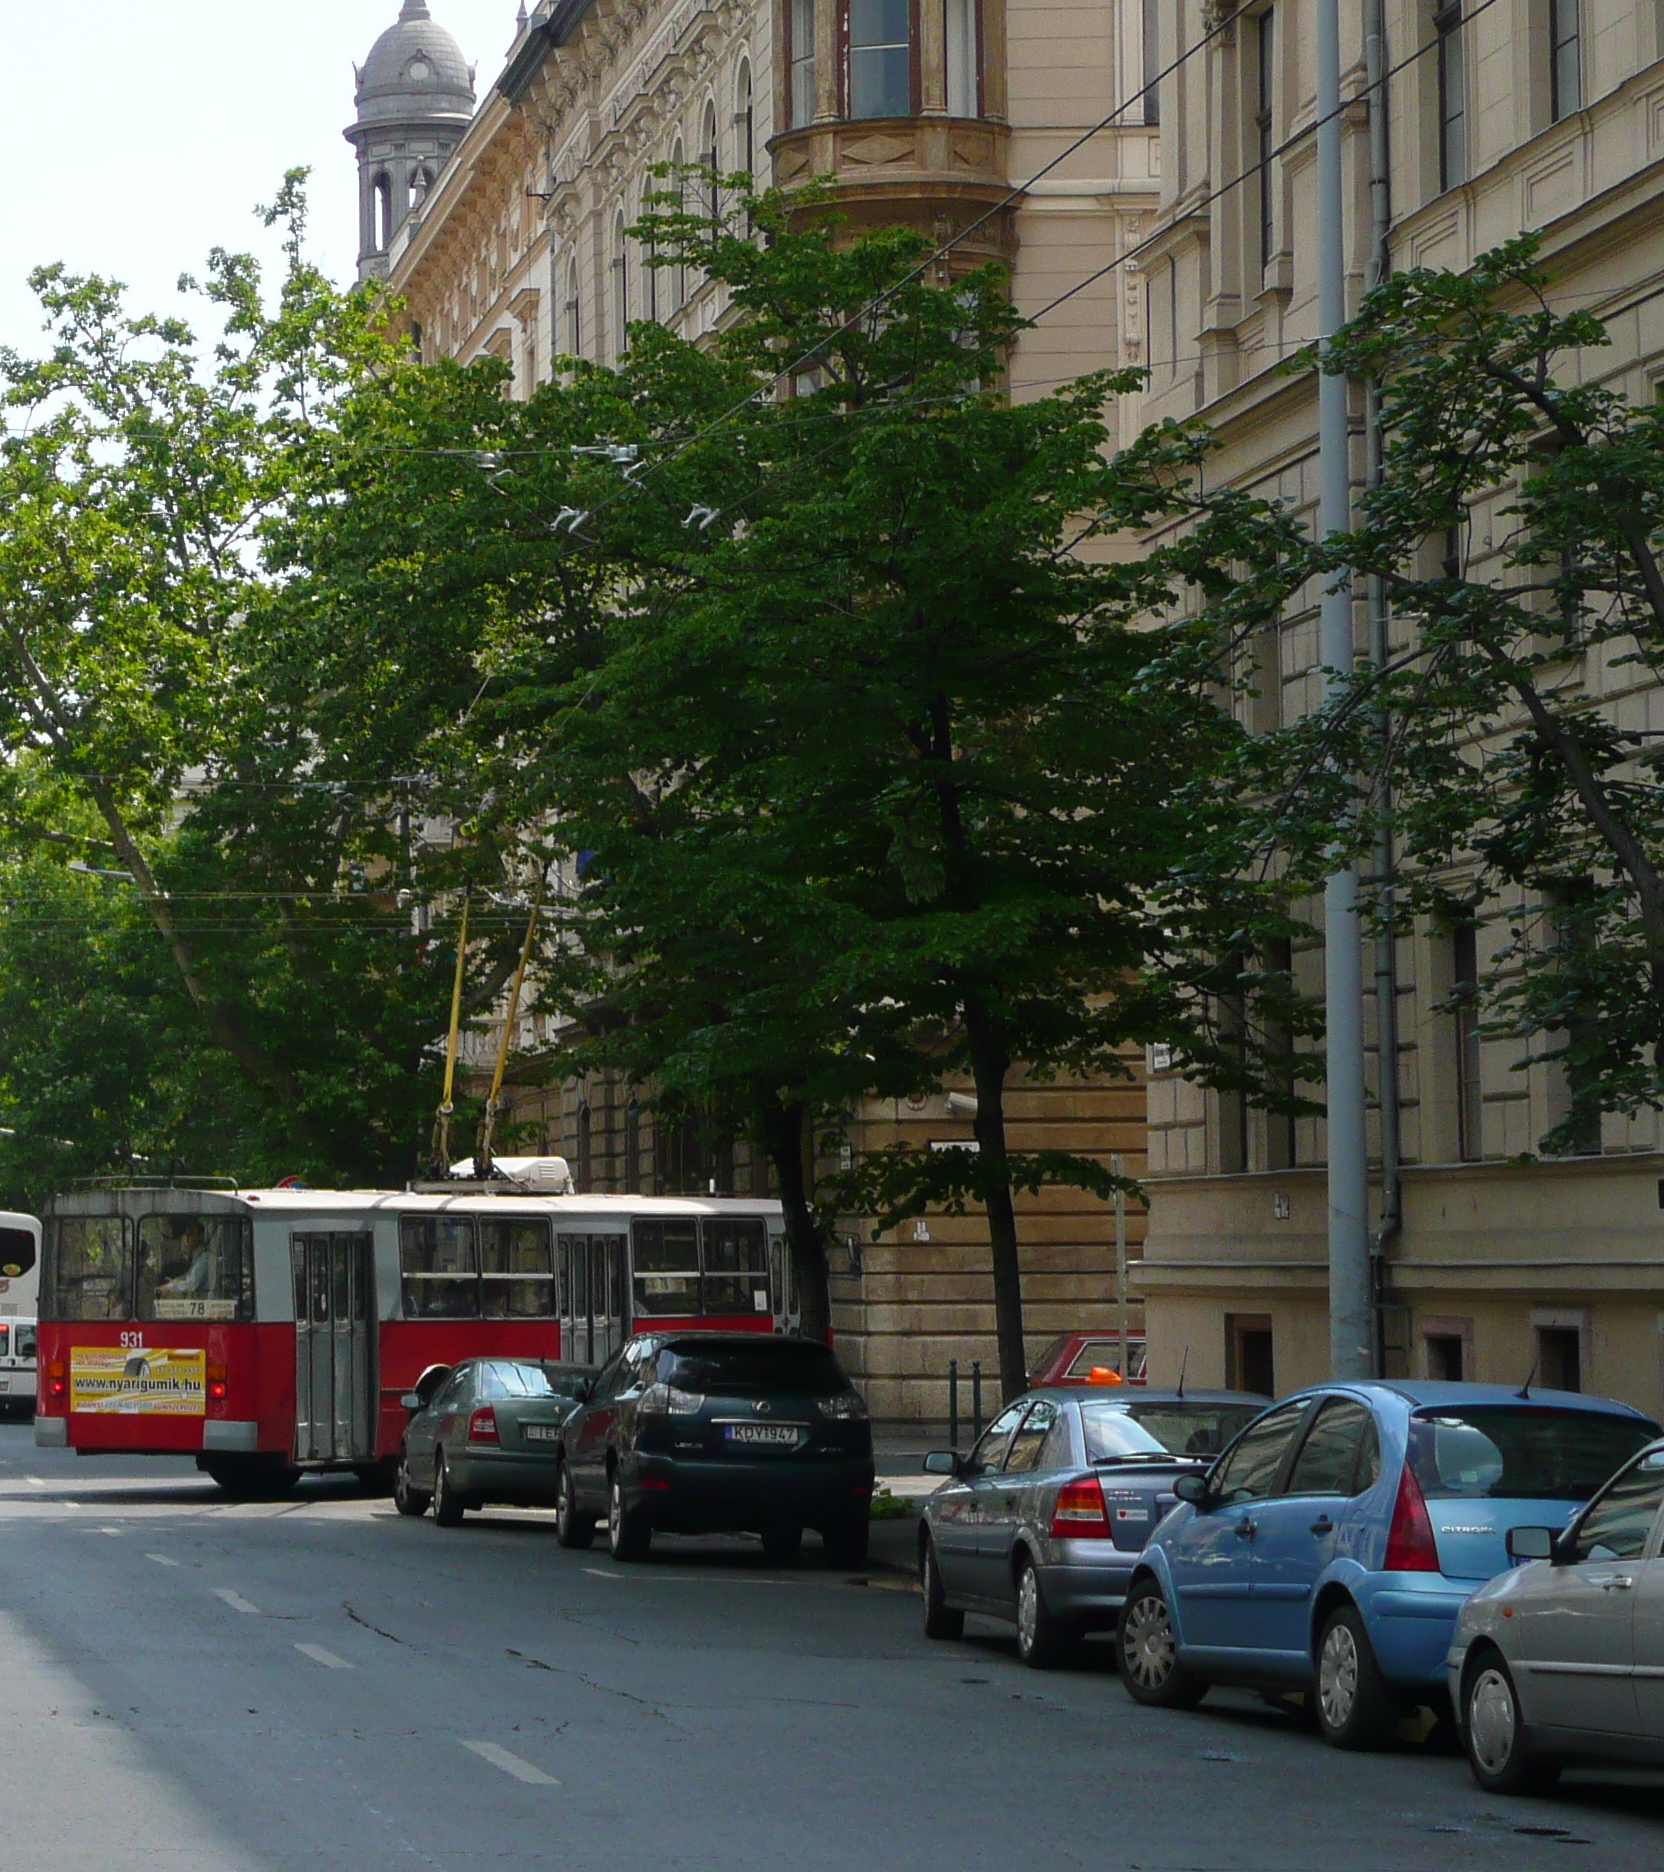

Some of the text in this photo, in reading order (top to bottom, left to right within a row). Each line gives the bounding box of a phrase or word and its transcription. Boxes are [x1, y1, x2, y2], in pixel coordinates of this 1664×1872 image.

[190, 1302, 205, 1316] 78
[120, 1331, 143, 1349] 931
[75, 1376, 201, 1393] www.nyarigumik.hu
